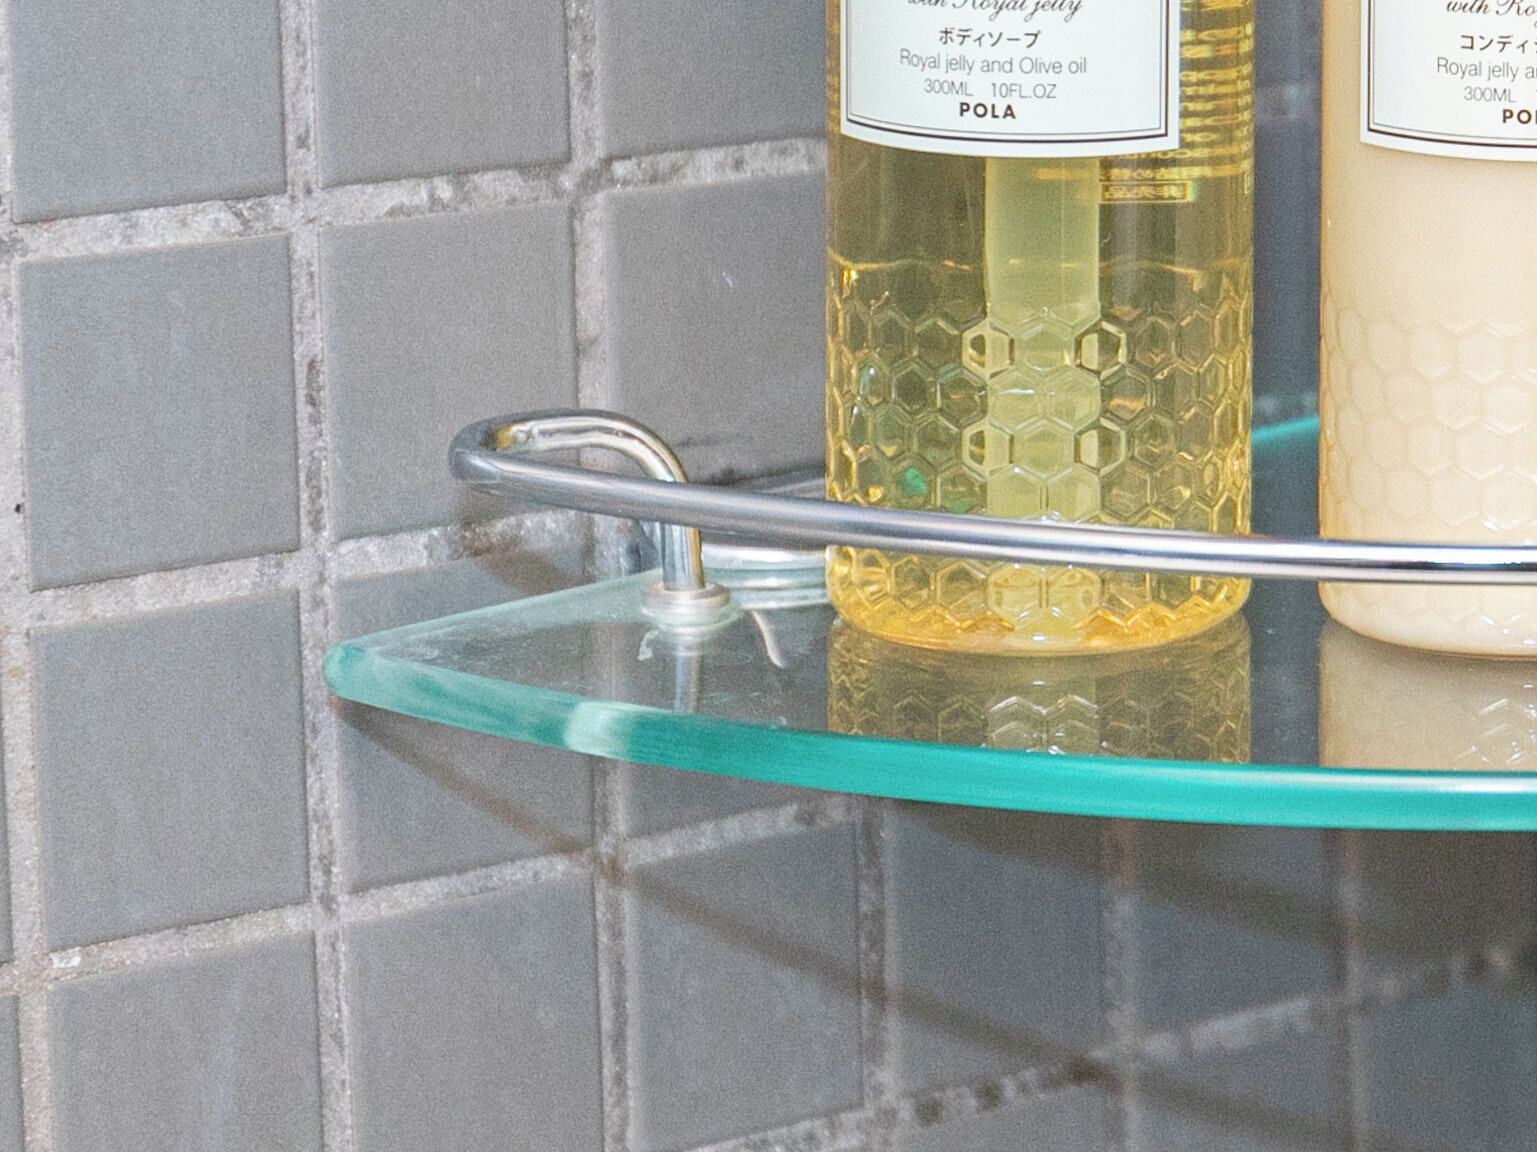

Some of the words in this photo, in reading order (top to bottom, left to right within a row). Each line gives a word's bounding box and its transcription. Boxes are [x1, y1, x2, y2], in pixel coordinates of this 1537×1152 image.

[939, 27, 1041, 48] ボディソープ
[900, 49, 940, 70] Royal
[945, 53, 974, 75] jelly
[981, 56, 1013, 73] and
[1019, 57, 1062, 74] Olive
[1068, 56, 1087, 74] oil
[1437, 57, 1482, 79] Royal
[1487, 62, 1519, 81] jelly
[923, 78, 973, 97] 300ML
[991, 83, 1057, 98] 10FL.OZ
[1464, 87, 1517, 103] 300ML
[959, 103, 1016, 119] POLA
